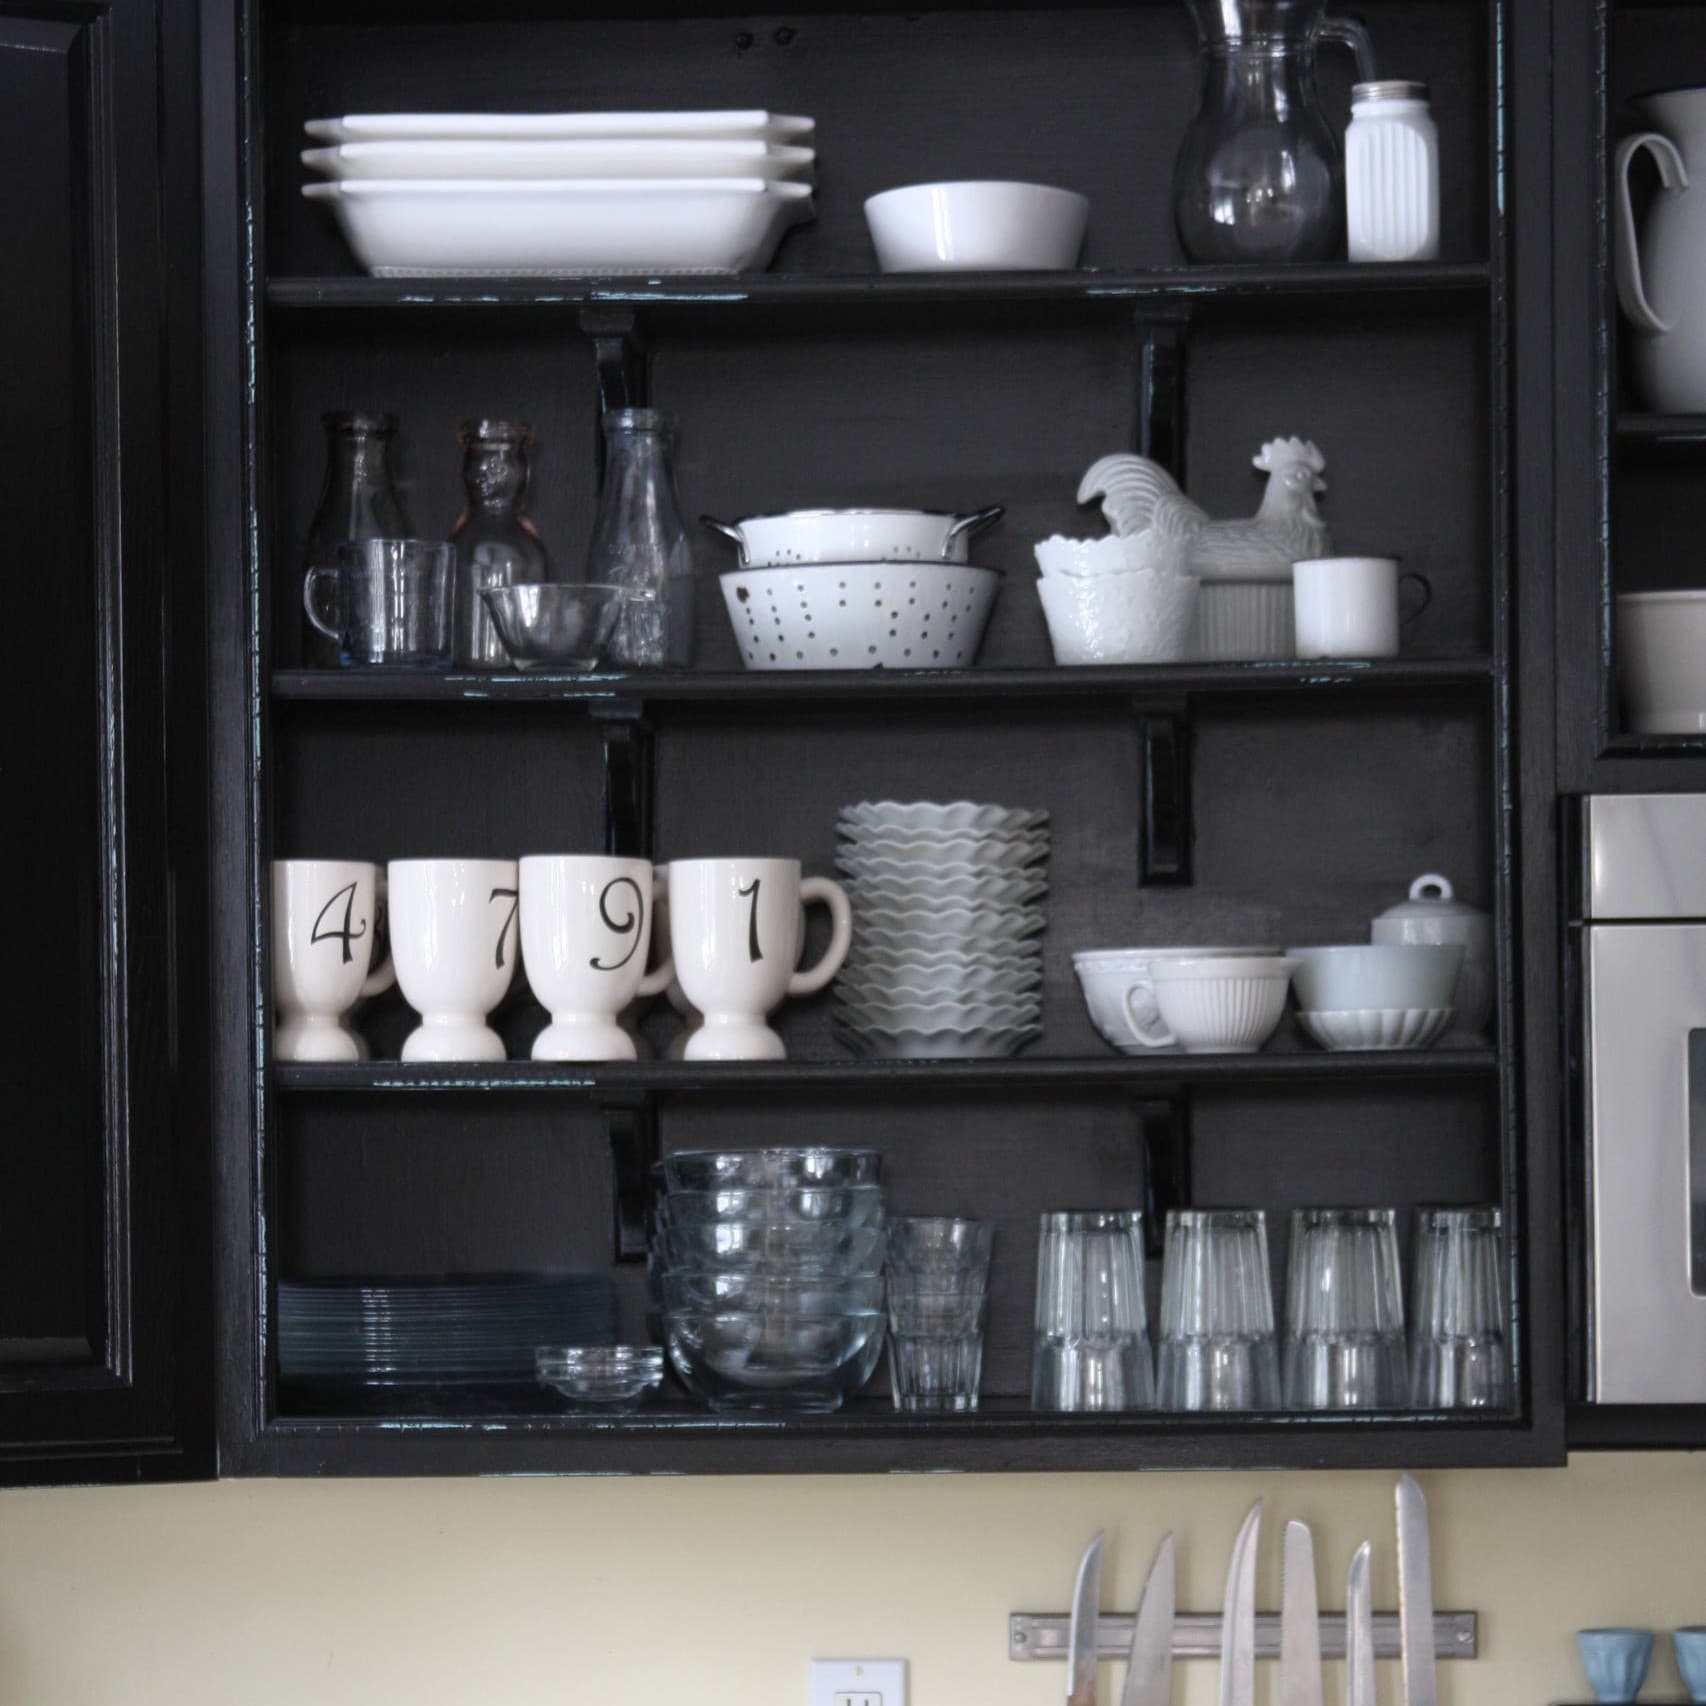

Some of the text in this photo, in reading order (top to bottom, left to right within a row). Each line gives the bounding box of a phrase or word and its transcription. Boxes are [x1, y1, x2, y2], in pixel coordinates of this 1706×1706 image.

[311, 881, 366, 965] 4
[488, 888, 518, 969] 7
[590, 877, 644, 970] 9
[738, 878, 763, 963] 1
